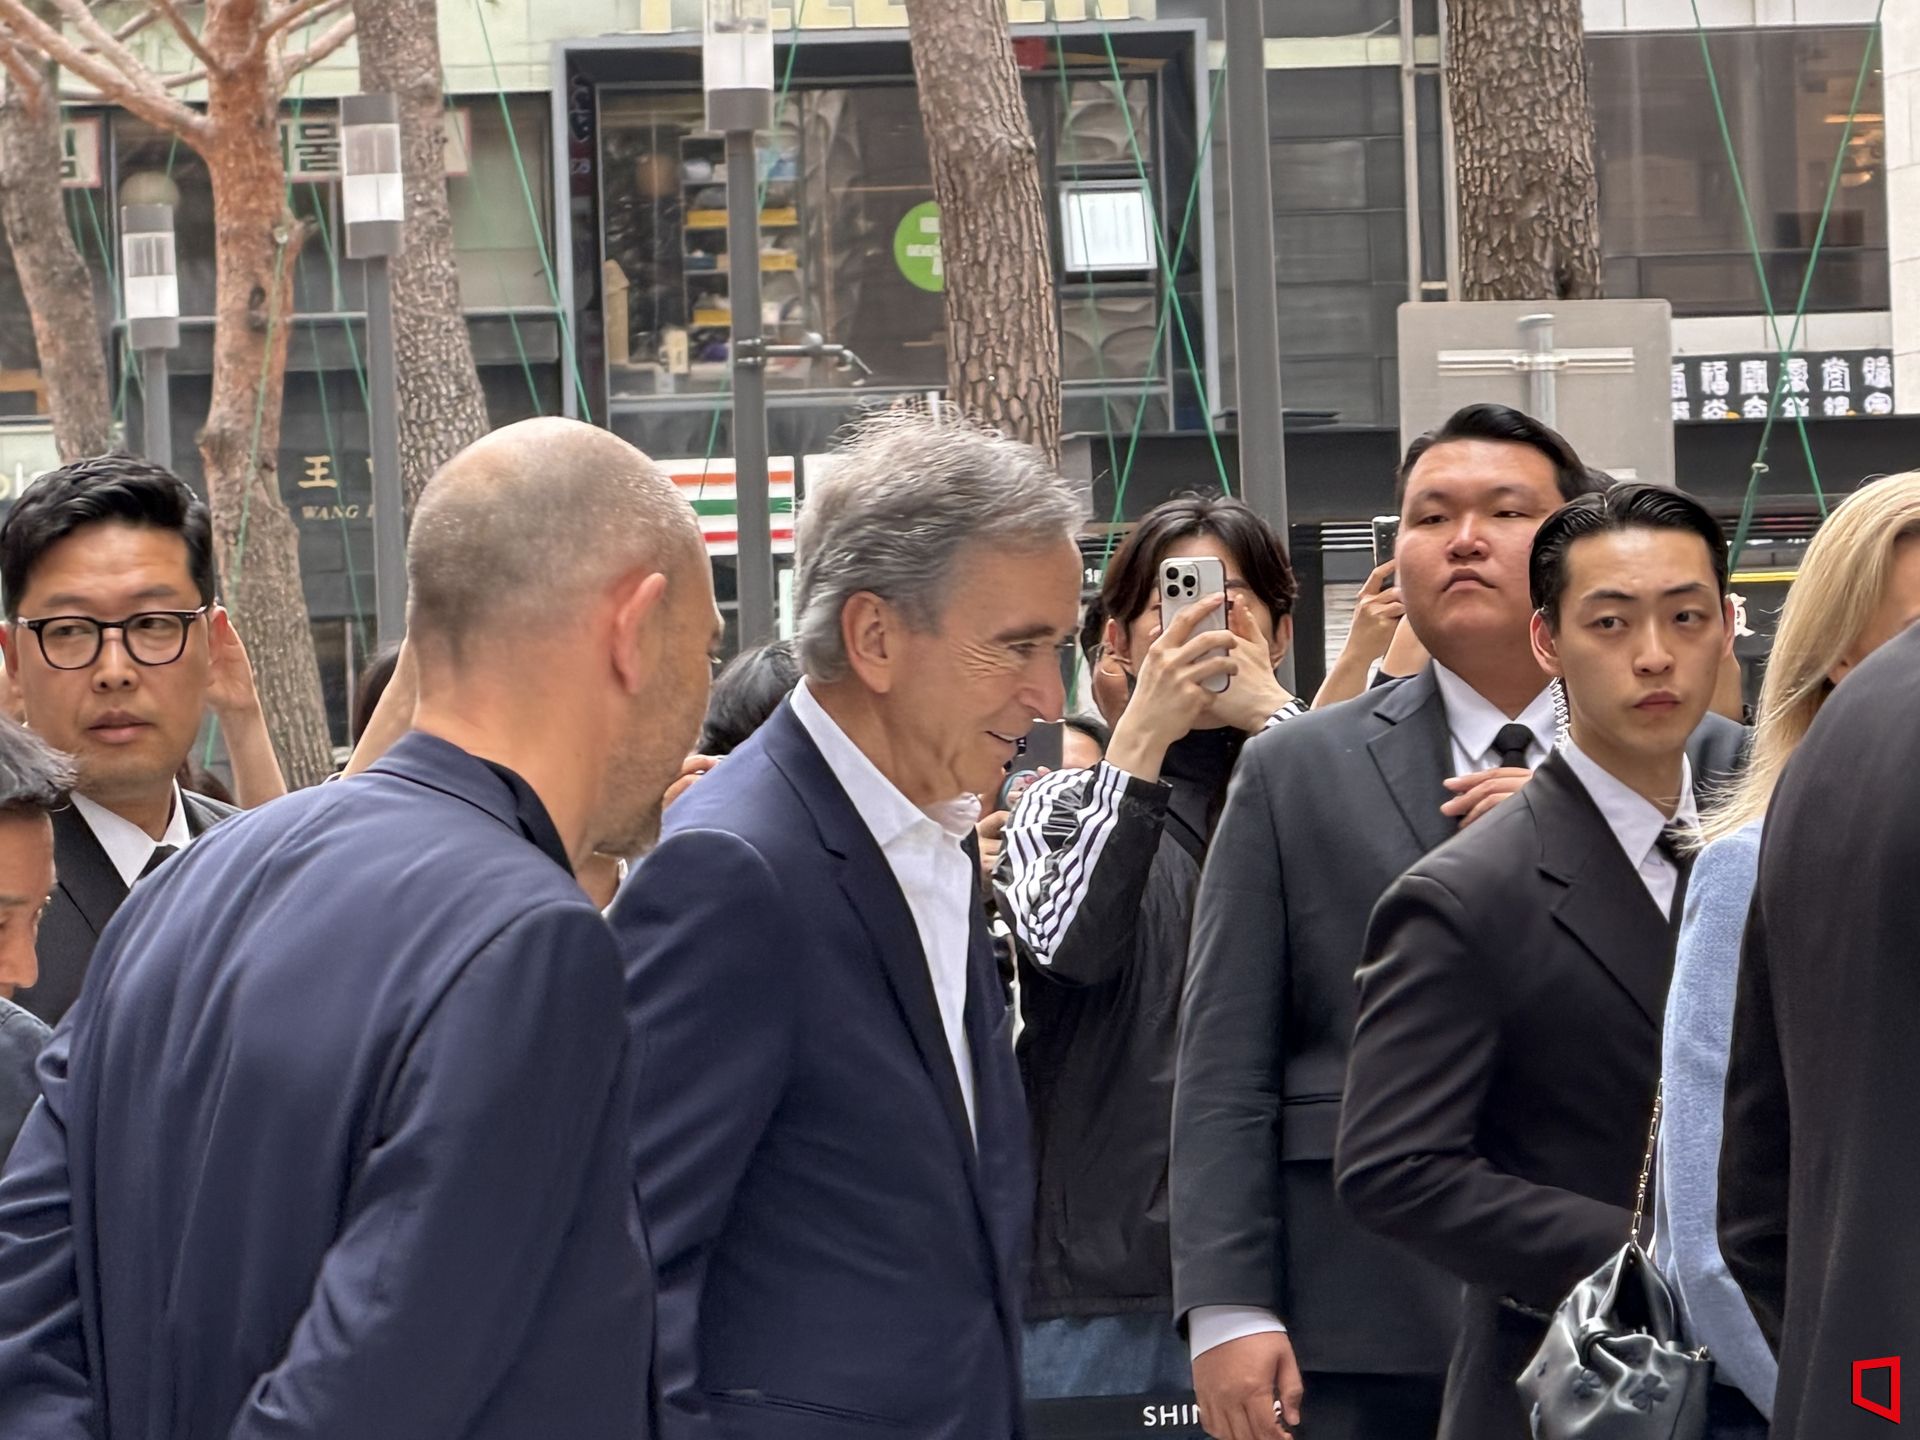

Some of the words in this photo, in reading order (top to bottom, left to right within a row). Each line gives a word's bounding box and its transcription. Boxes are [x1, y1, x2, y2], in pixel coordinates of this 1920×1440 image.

[280, 123, 341, 171] 물
[298, 455, 337, 488] 王
[302, 504, 359, 520] WANG
